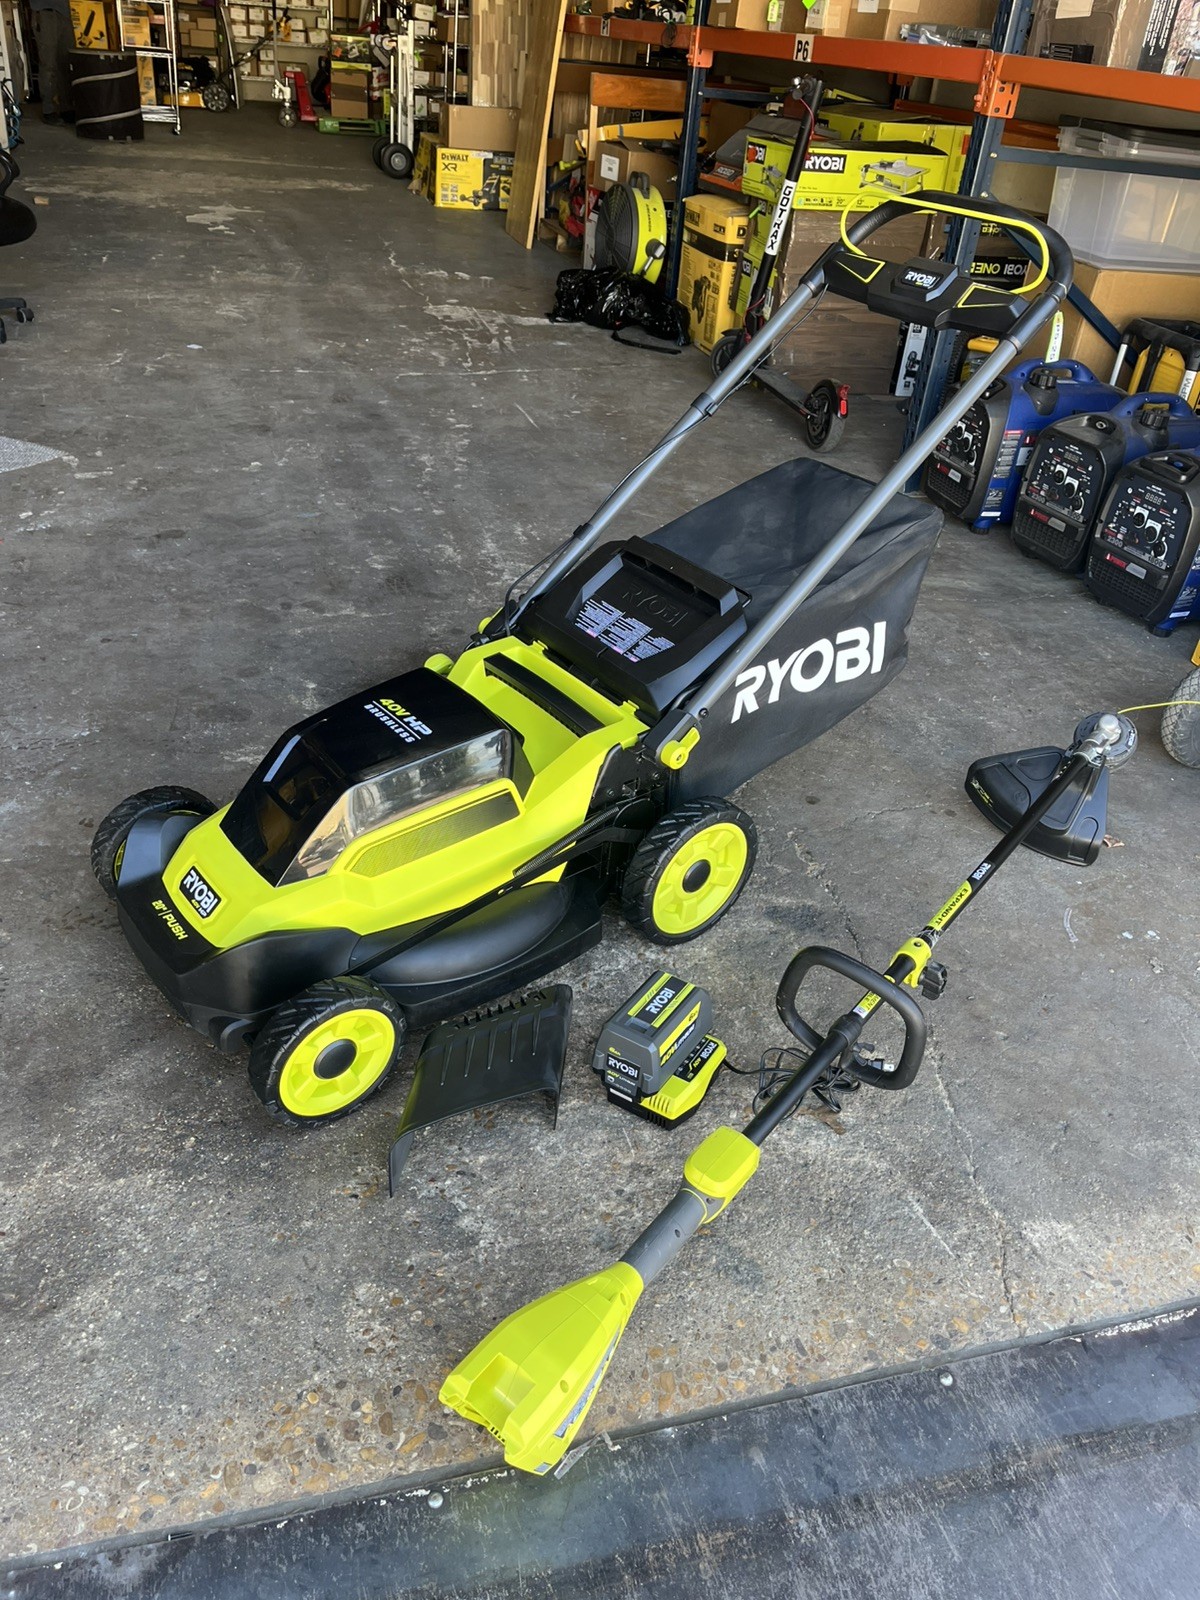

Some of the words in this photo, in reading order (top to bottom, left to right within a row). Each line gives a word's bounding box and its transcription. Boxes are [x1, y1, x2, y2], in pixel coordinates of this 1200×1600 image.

[796, 40, 809, 60] P6
[442, 162, 458, 172] XR
[804, 156, 845, 171] RYOBI
[905, 271, 936, 285] RYOBI
[731, 621, 886, 723] RYOBI
[363, 703, 416, 743] BRUSHLESS
[379, 698, 411, 717] 40V
[403, 715, 433, 736] HP
[972, 863, 991, 880] RYOBI
[184, 869, 218, 913] RYOBI
[162, 913, 188, 940] PUSH
[645, 987, 676, 1014] RYOBI
[701, 1042, 717, 1059] RYOBI
[608, 1057, 638, 1078] RYOBI
